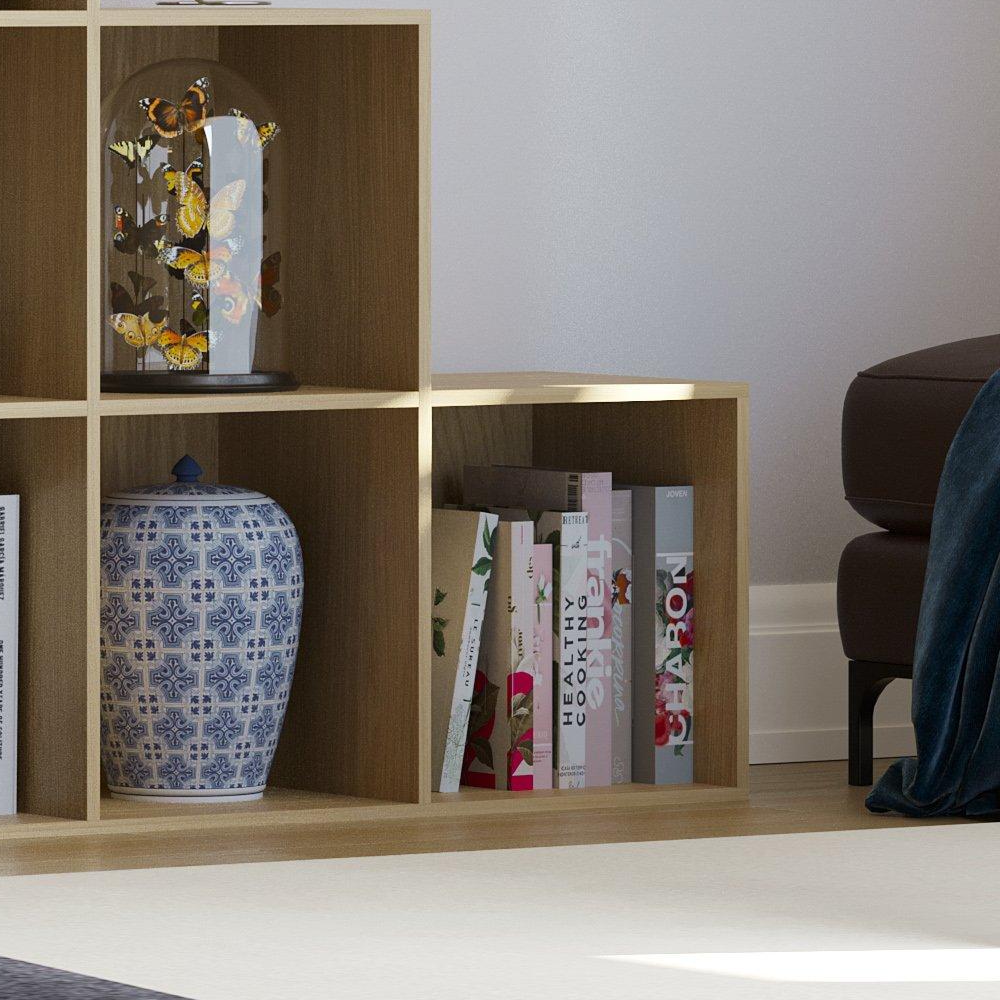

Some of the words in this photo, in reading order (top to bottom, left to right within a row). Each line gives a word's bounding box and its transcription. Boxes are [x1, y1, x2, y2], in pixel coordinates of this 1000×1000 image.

[665, 489, 689, 499] JOVEN
[563, 597, 575, 726] HEALTHY
[576, 595, 588, 727] COOKING
[587, 533, 612, 710] frankie
[665, 556, 688, 746] CHABON
